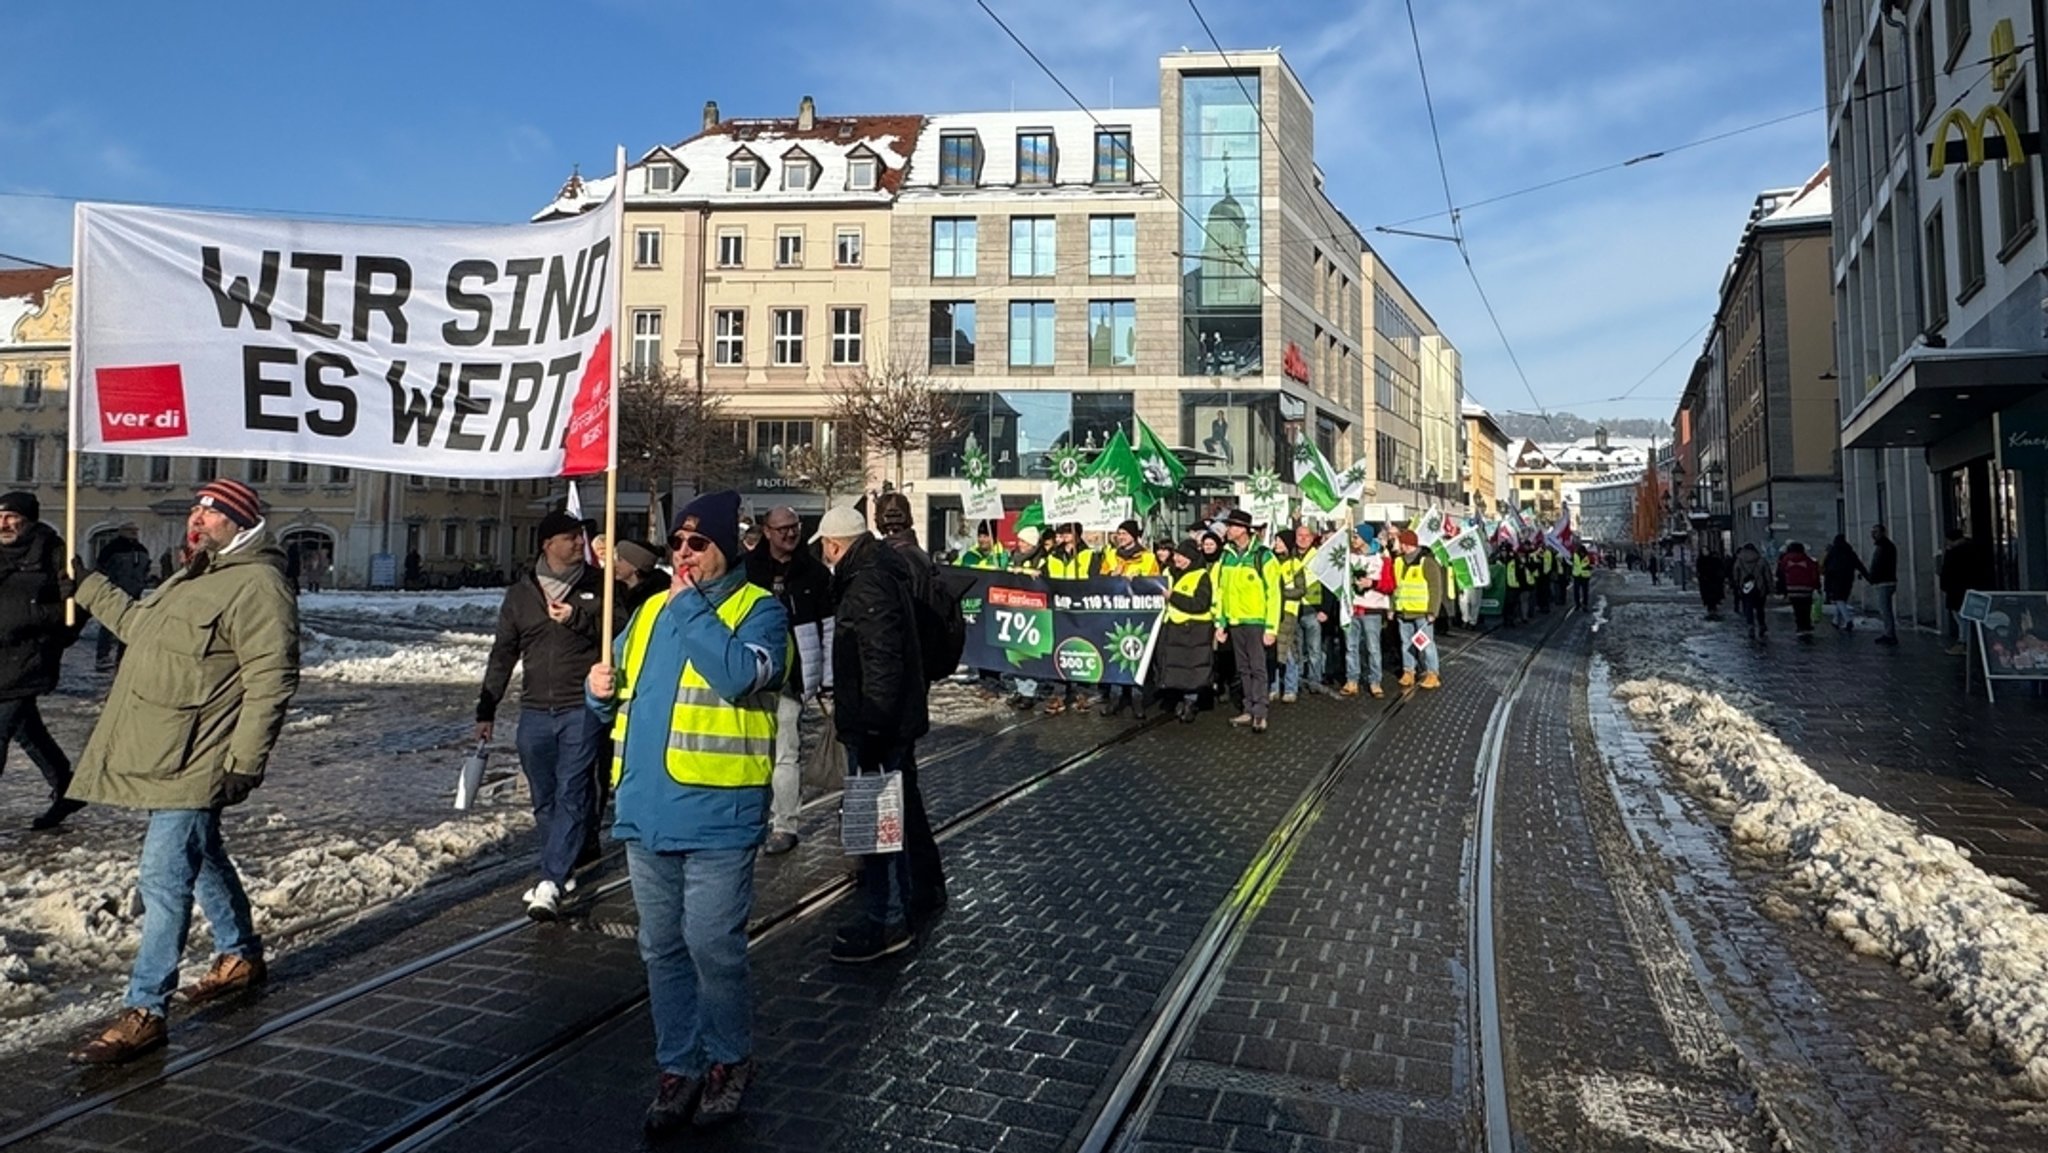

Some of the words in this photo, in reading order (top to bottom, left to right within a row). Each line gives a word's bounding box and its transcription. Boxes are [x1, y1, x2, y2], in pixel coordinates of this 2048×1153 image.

[202, 246, 412, 344] WIR
[442, 236, 611, 346] SIND
[105, 409, 180, 428] ver.di
[243, 345, 359, 437] ES
[1060, 657, 1083, 670] 300
